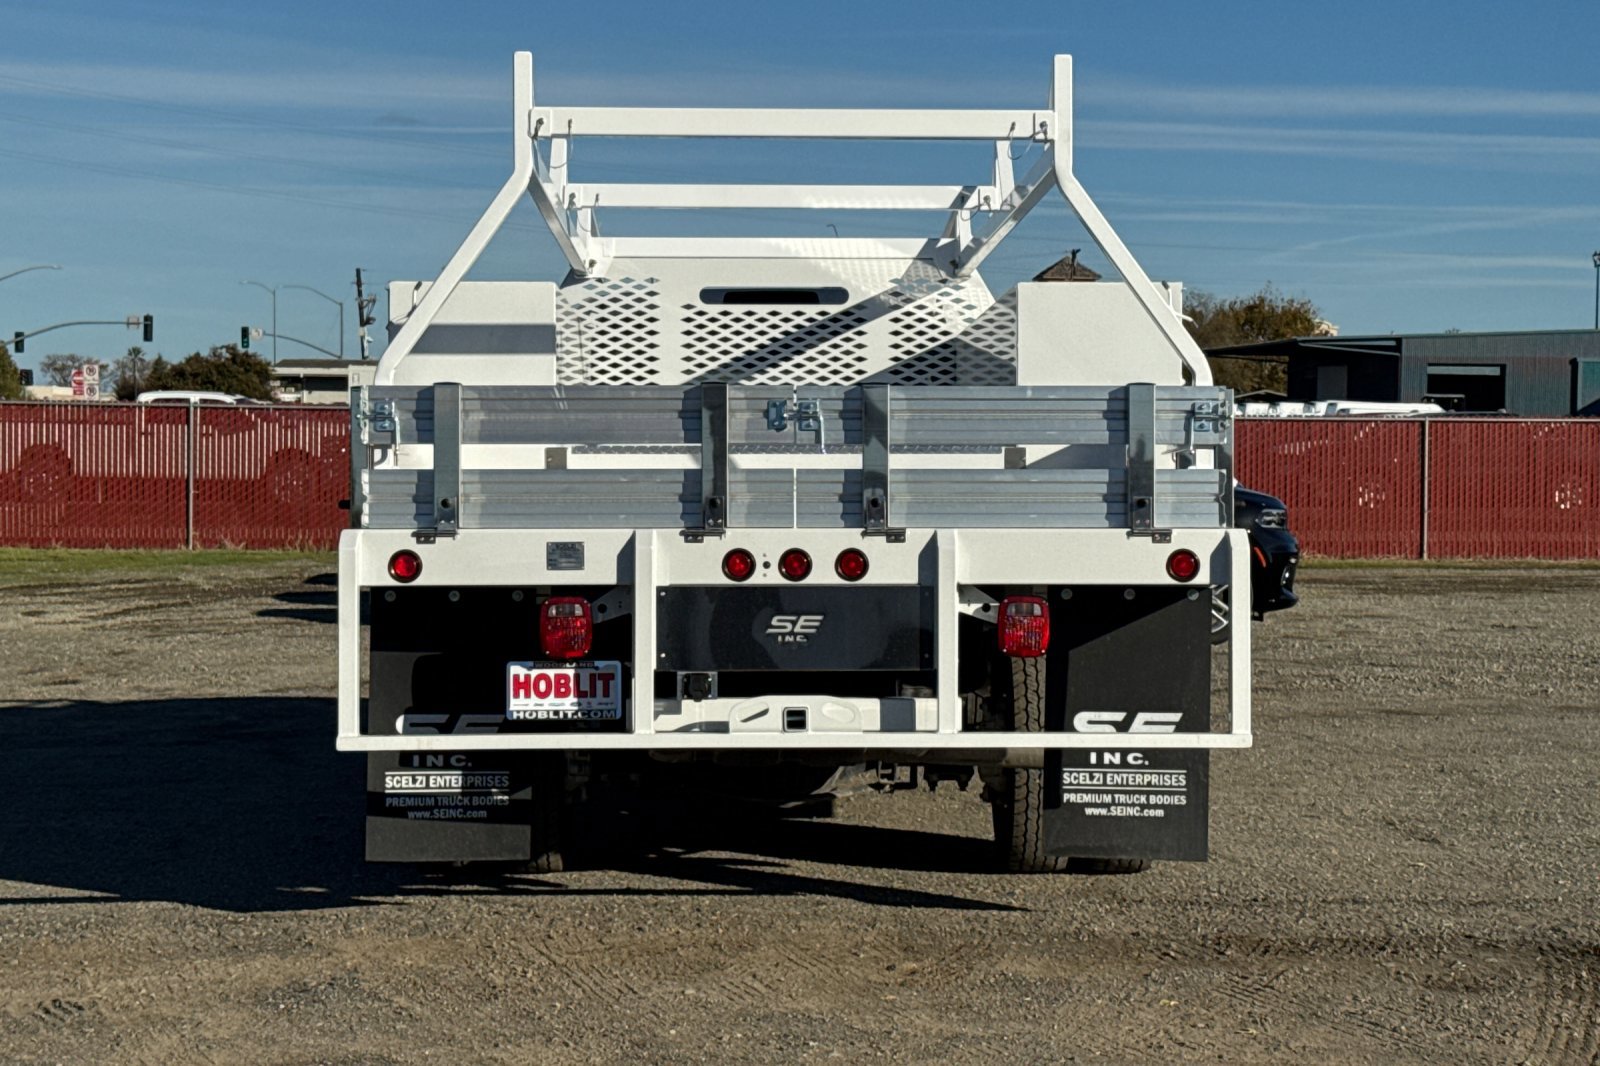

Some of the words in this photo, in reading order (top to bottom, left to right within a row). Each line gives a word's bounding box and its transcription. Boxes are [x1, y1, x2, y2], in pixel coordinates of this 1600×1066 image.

[766, 615, 824, 633] SE
[513, 673, 615, 699] HOBLIT
[512, 710, 615, 720] HOBLIT.COM
[412, 754, 472, 767] INC.
[1090, 752, 1149, 765] INC.
[384, 776, 426, 788] SCELZI
[429, 775, 509, 787] ENTERPRISES
[1062, 772, 1103, 785] SCELZI
[1106, 773, 1186, 786] ENTERPRISES
[385, 796, 434, 807] PREMIUM
[438, 796, 469, 806] TRUCK
[472, 795, 509, 806] BODIES
[1063, 793, 1111, 804] PREMIUM
[1114, 794, 1147, 804] TRUCK
[1149, 795, 1186, 805] BODIES
[408, 809, 487, 819] www.SEINC.com
[1084, 806, 1164, 817] www.SEINC.com
